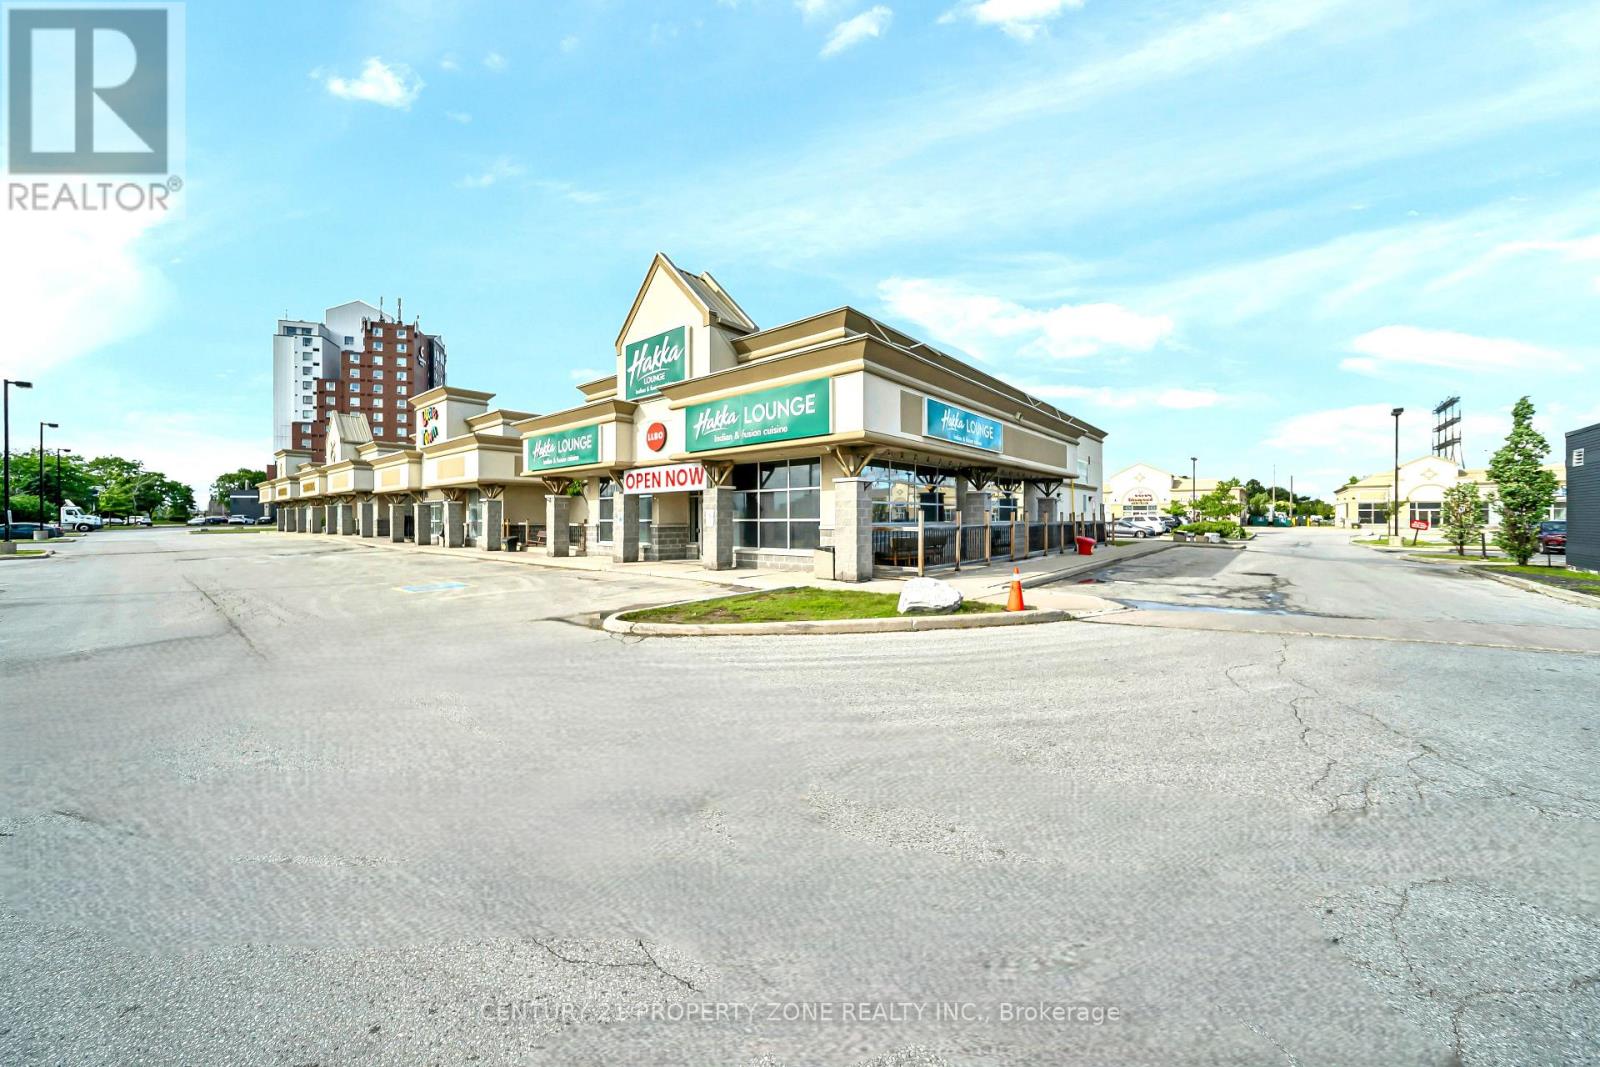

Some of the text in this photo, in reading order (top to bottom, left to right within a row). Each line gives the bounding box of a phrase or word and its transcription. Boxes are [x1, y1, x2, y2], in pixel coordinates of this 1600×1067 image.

[627, 336, 684, 387] Hakka
[643, 372, 666, 384] LOUNGE
[693, 393, 816, 440] Hakka LOUNGE
[941, 409, 994, 439] Hakka LOUNGE
[713, 424, 788, 443] Indian & fusion cuisine
[532, 437, 557, 462] Hakka
[557, 434, 593, 454] LOUNGE
[625, 467, 706, 490] OPEN NOW
